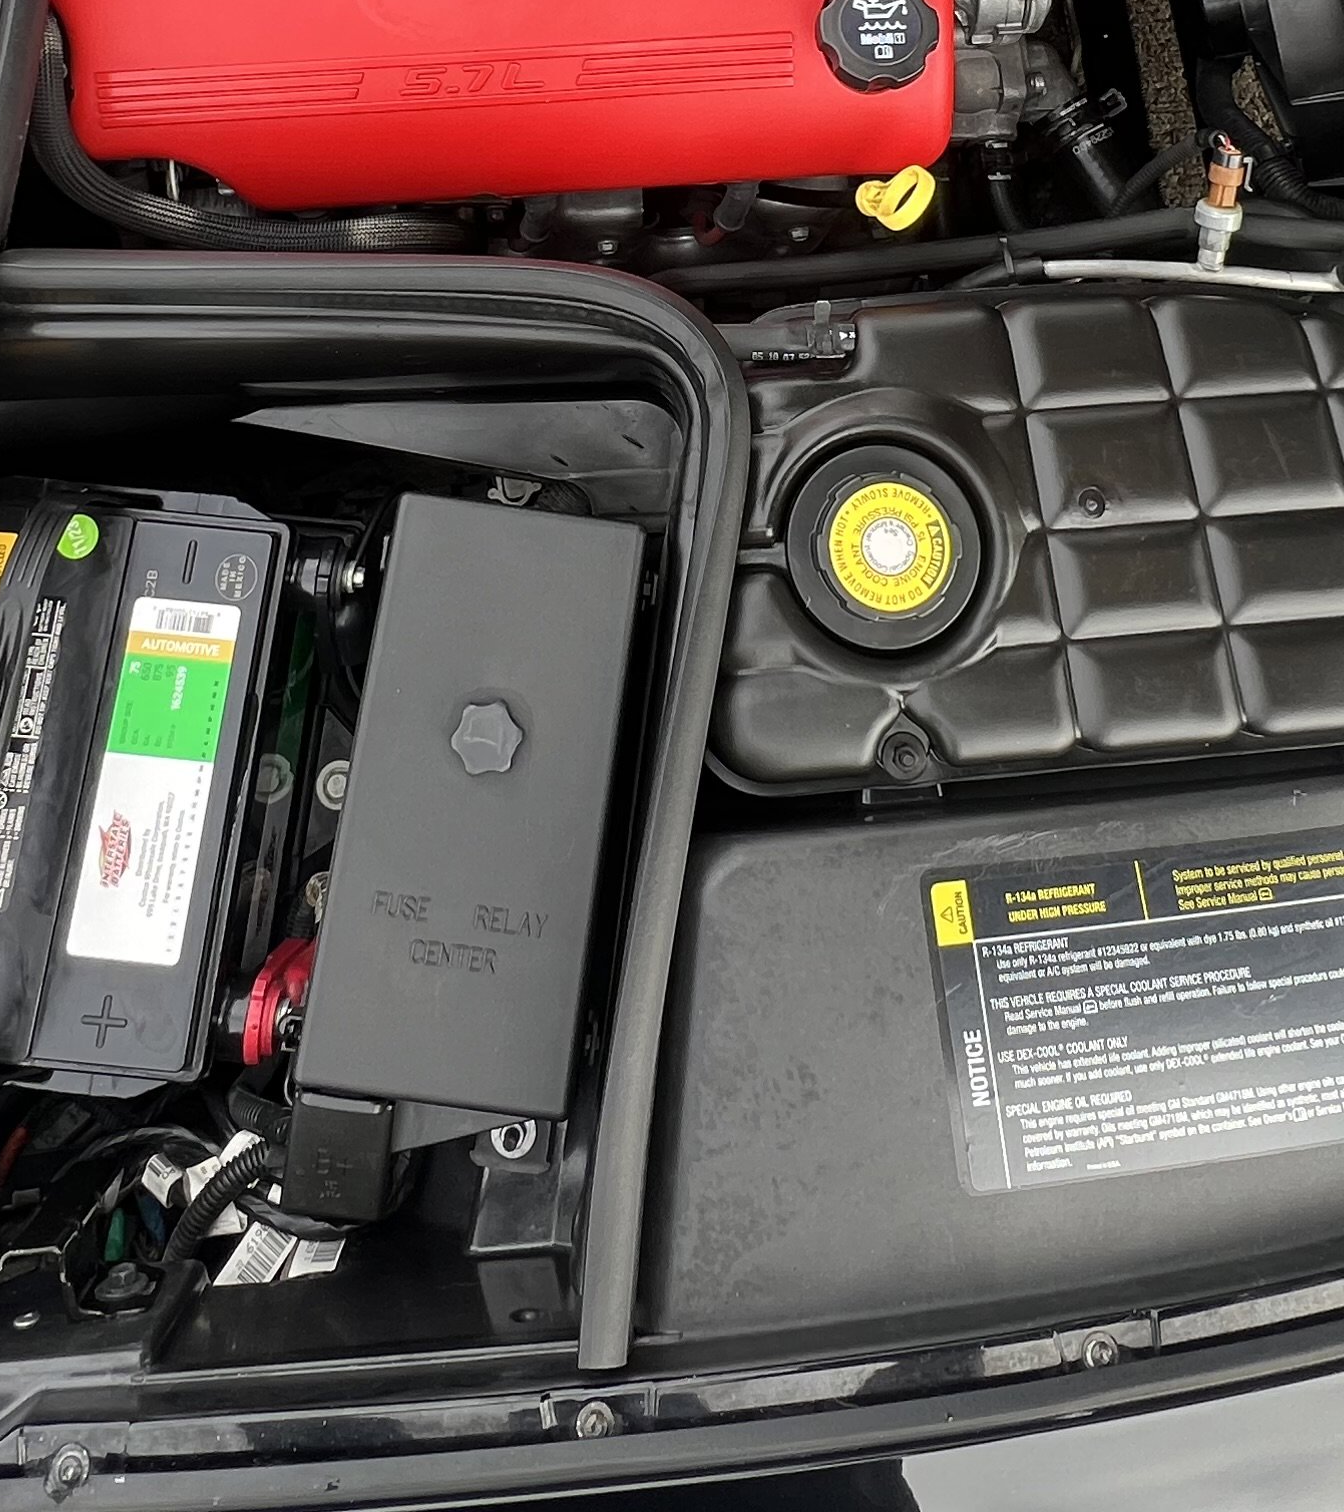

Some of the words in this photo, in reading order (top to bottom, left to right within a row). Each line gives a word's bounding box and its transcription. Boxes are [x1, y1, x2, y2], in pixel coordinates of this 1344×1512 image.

[399, 61, 548, 99] 5.7L
[851, 488, 888, 511] SLOWLY
[892, 488, 930, 514] REMOVE
[836, 516, 848, 537] HOT
[853, 506, 903, 536] PRESSURE
[904, 512, 918, 528] PSI
[918, 531, 926, 542] 15
[834, 540, 848, 572] WHEN
[851, 543, 888, 587] COOLANT
[894, 554, 926, 587] ENGINE
[923, 537, 945, 587] CAUTION
[220, 562, 231, 591] MADE
[229, 570, 236, 582] IN
[234, 555, 247, 598] MEXICO
[844, 571, 883, 604] REMOVE
[885, 595, 906, 605] NOT
[910, 586, 923, 600] DO
[141, 637, 220, 657] AUTOMOTIVE
[128, 660, 141, 674] 75
[99, 811, 122, 887] INTERSTATE
[109, 819, 130, 887] BATTERIES
[1172, 869, 1204, 882] System
[1203, 866, 1214, 878] to
[1213, 865, 1226, 876] be
[1226, 860, 1260, 874] serviced
[1260, 859, 1271, 871] by
[1272, 855, 1306, 870] qualified
[1306, 850, 1344, 866] personnel
[1005, 890, 1036, 904] R-134a
[1037, 883, 1094, 900] REFRIGERANT
[1177, 898, 1195, 910] See
[1195, 895, 1226, 908] Service
[1227, 890, 1258, 904] Manual
[372, 890, 431, 922] FUSE
[474, 904, 549, 937] RELAY
[955, 891, 968, 935] CAUTION
[1008, 908, 1038, 922] UNDER
[1038, 905, 1061, 918] HIGH
[1061, 900, 1106, 916] PRESSURE
[410, 939, 497, 973] CENTER
[981, 944, 1013, 957] R-134a
[1013, 937, 1068, 954] REFRIGERANT
[989, 996, 1009, 1010] THIS
[1009, 992, 1044, 1008] VEHICLE
[1045, 987, 1086, 1003] REQUIRES
[1087, 986, 1094, 1001] A
[1094, 983, 1129, 997] SPECIAL
[1129, 977, 1167, 993] COOLANT
[1169, 972, 1203, 988] SERVICE
[1203, 966, 1251, 983] PROCEDURE
[997, 1049, 1015, 1063] USE
[1065, 1038, 1104, 1054] COOLANT
[1106, 1035, 1127, 1050] ONLY
[964, 1029, 991, 1107] NOTICE
[1005, 1102, 1041, 1117] SPECIAL
[1041, 1097, 1073, 1113] ENGINE
[1074, 1095, 1089, 1108] OIL
[1089, 1090, 1132, 1106] REQUIRED
